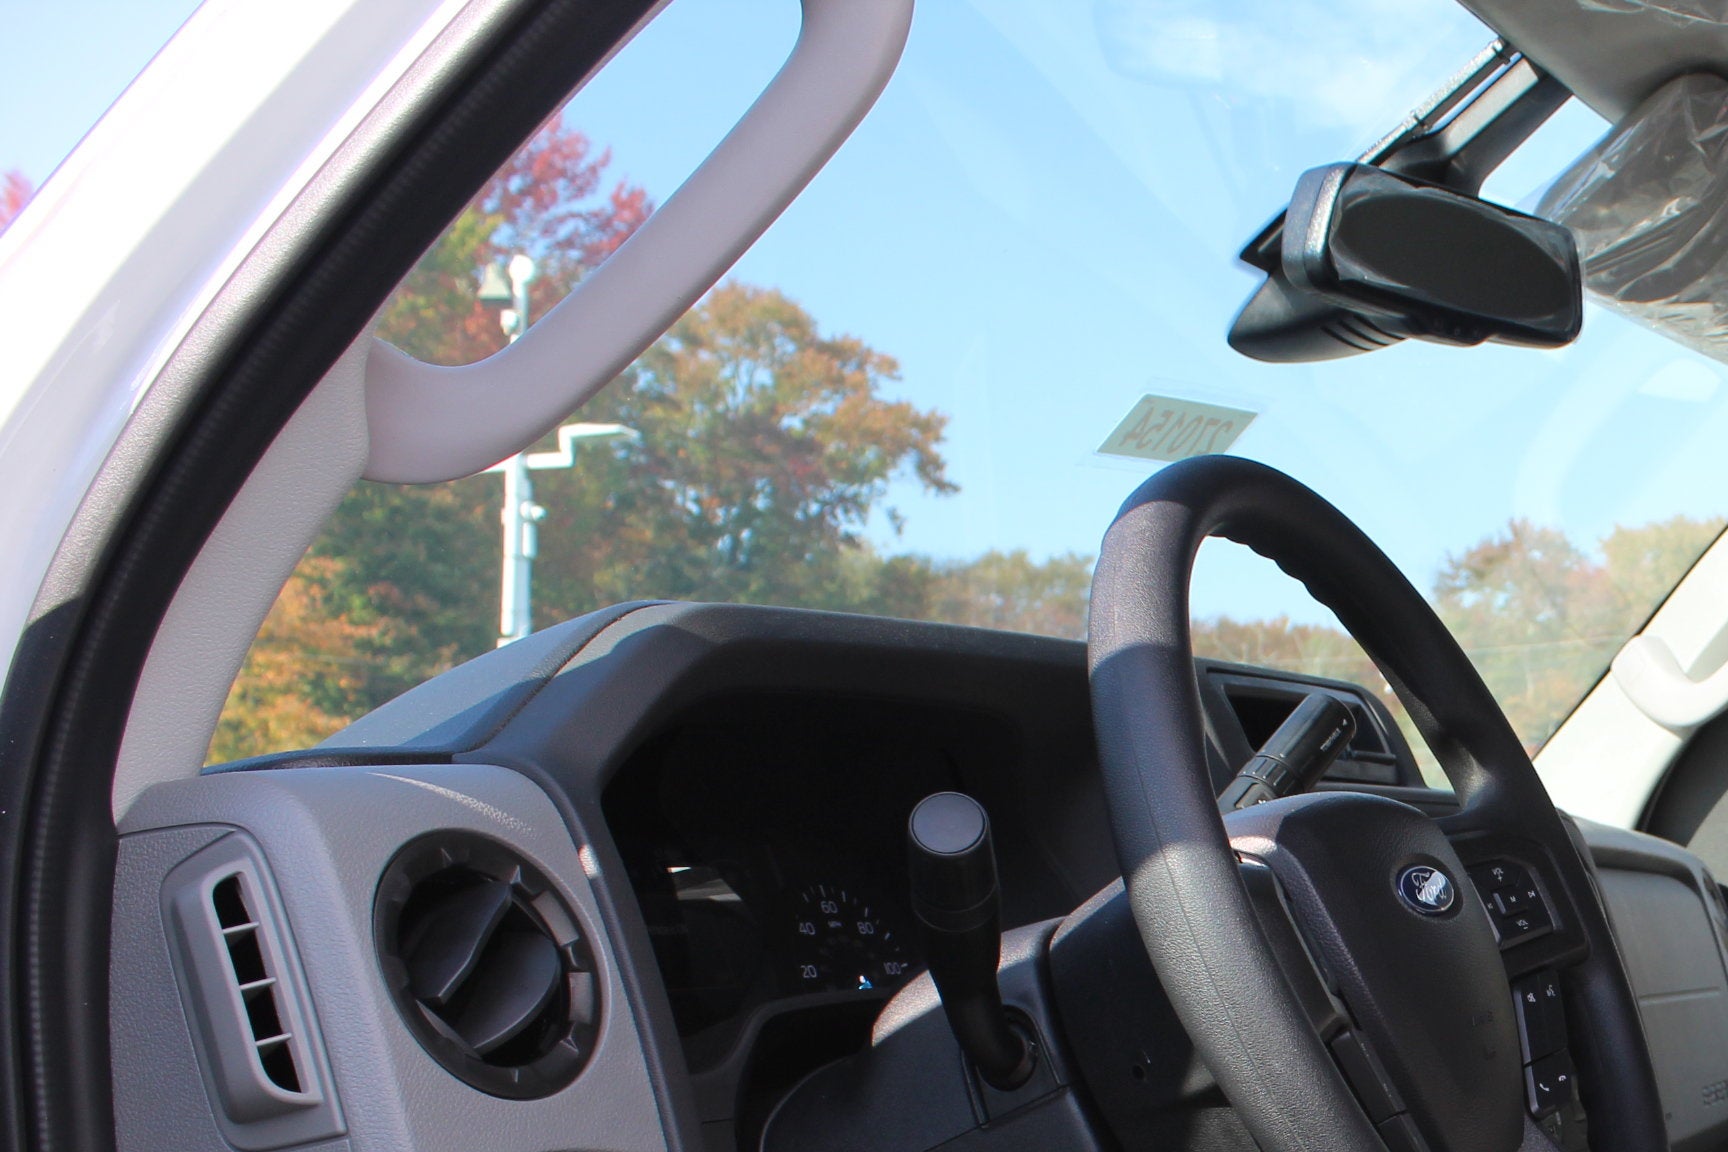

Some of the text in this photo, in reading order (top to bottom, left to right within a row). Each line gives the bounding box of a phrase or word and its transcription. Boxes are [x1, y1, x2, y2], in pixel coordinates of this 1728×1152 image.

[1411, 870, 1448, 903] Ford
[820, 900, 838, 914] 60
[798, 922, 816, 935] 40
[857, 921, 874, 934] 80
[800, 964, 818, 978] 20
[883, 961, 902, 975] 100
